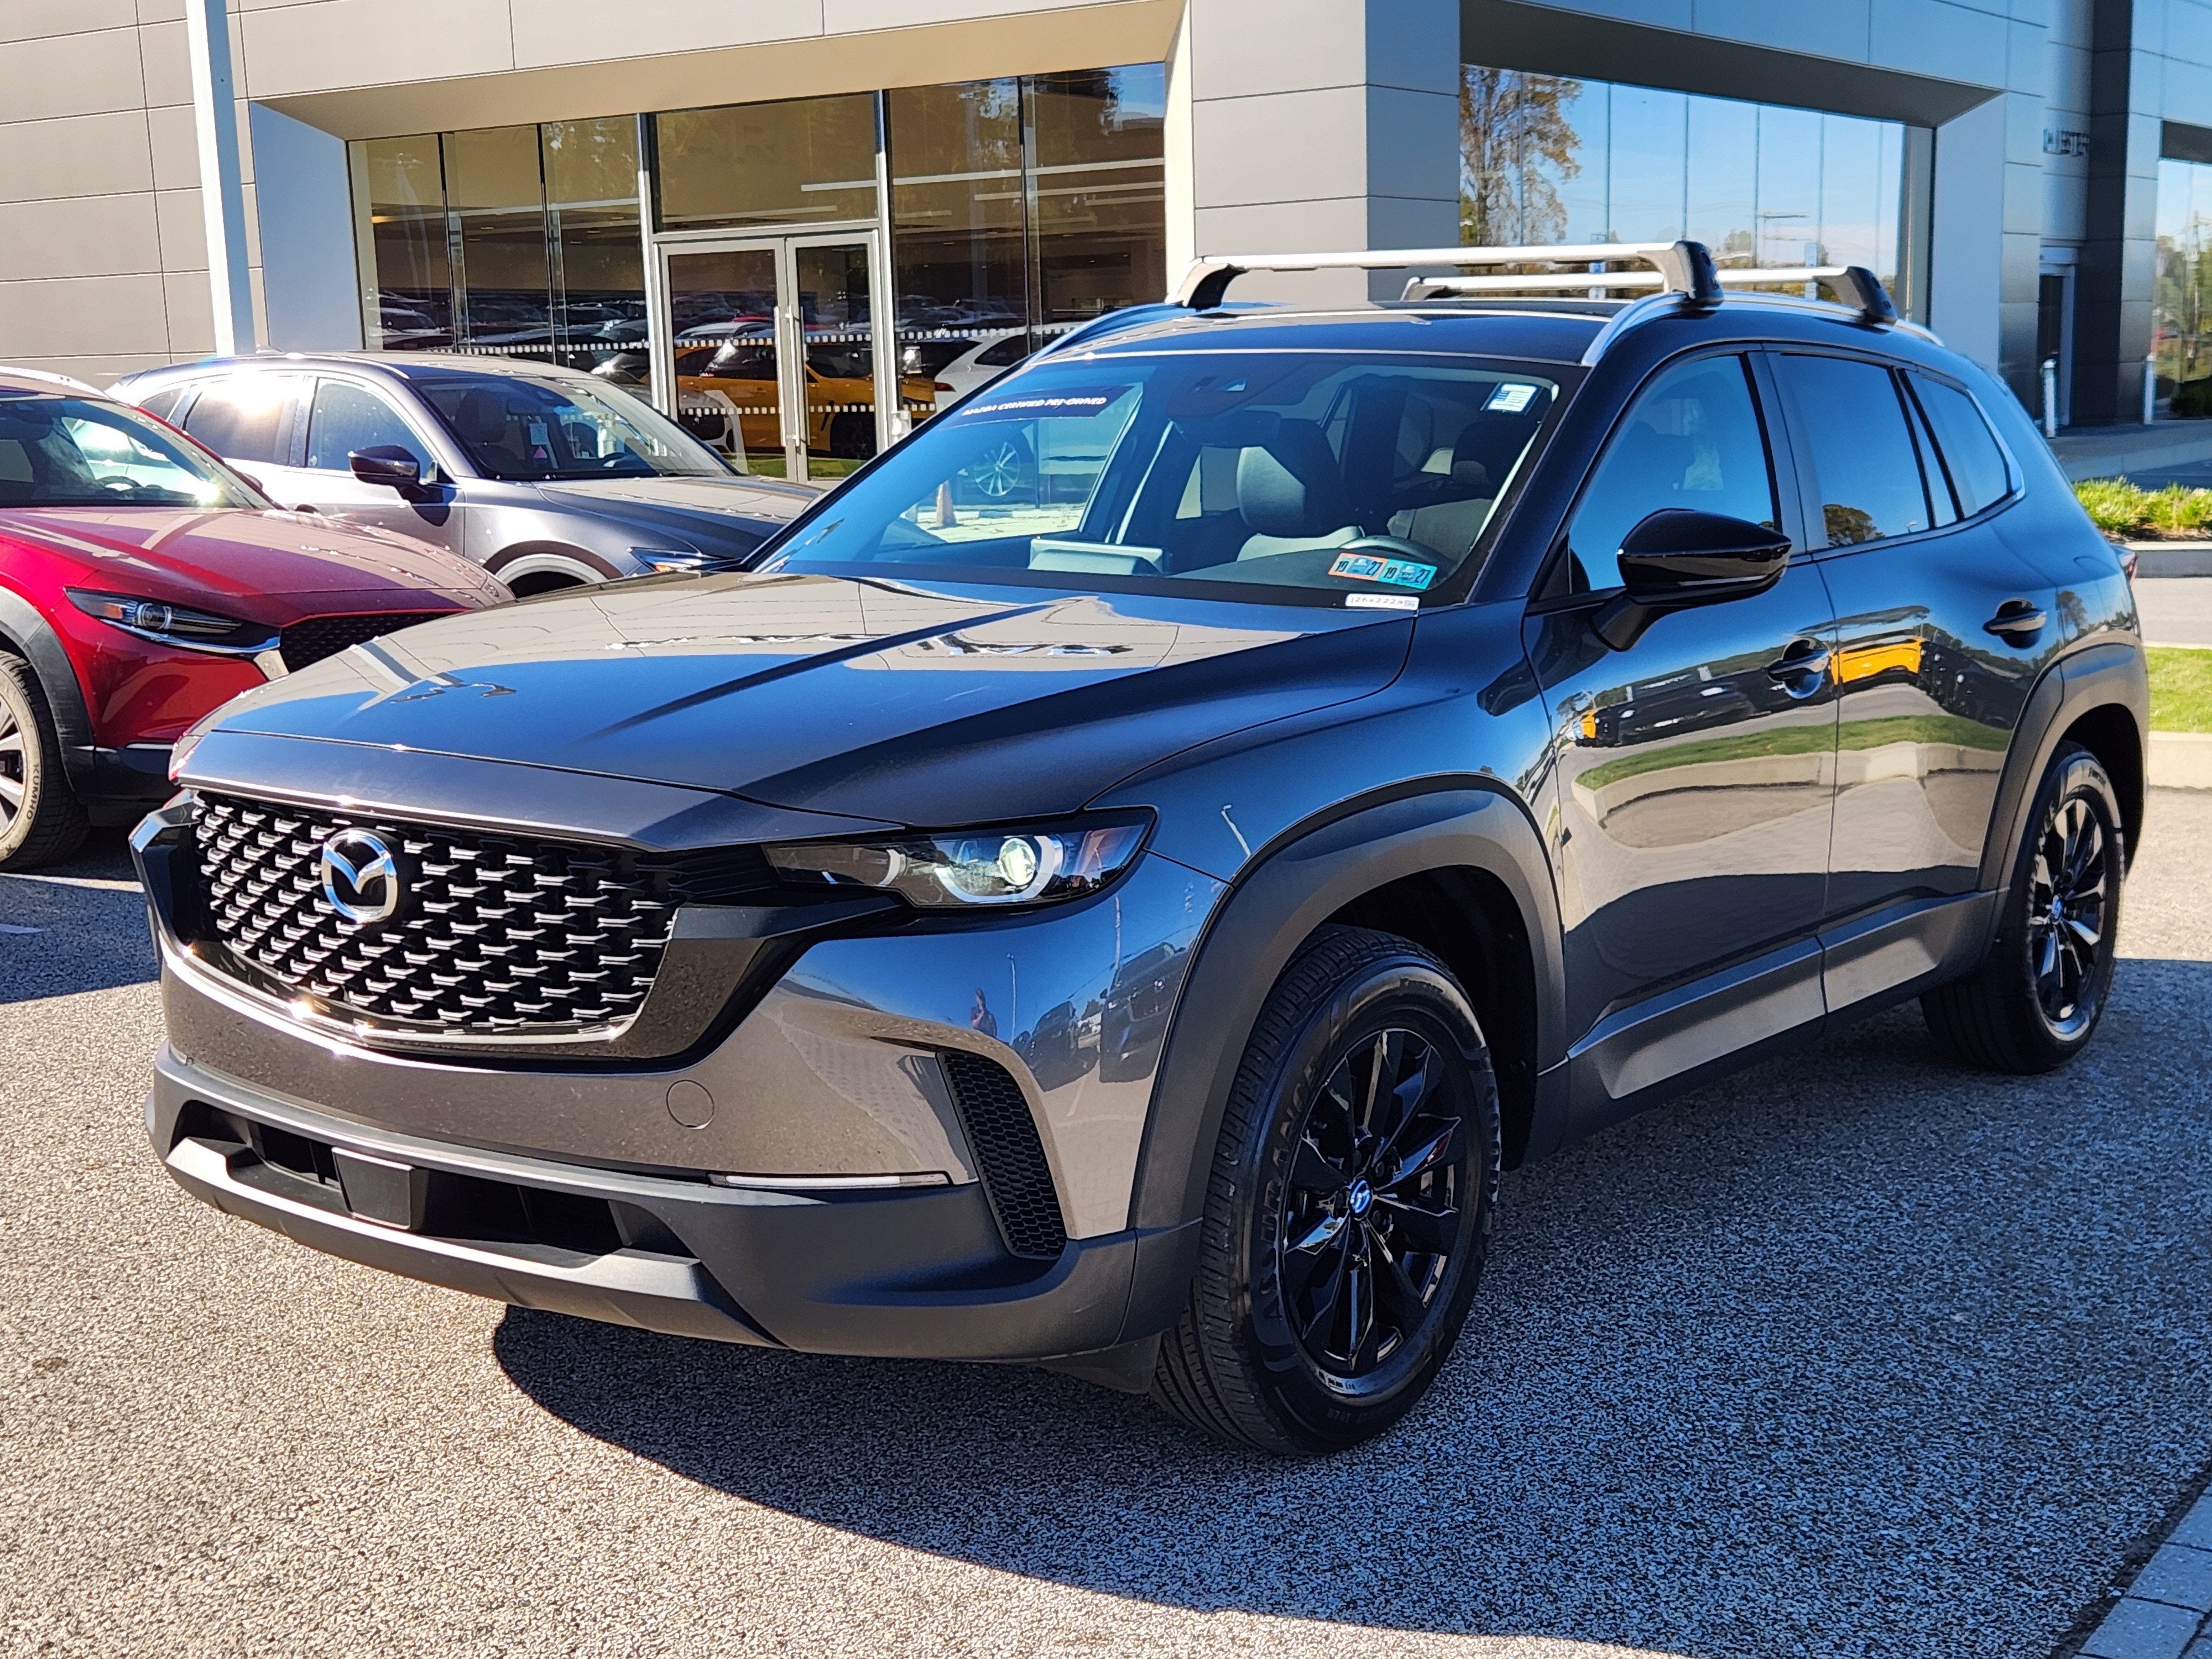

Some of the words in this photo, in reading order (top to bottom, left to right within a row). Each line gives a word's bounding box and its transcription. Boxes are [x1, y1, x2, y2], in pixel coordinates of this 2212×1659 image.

[1366, 561, 1383, 577] 27
[1415, 568, 1432, 585] 27
[26, 763, 40, 820] KUMHO
